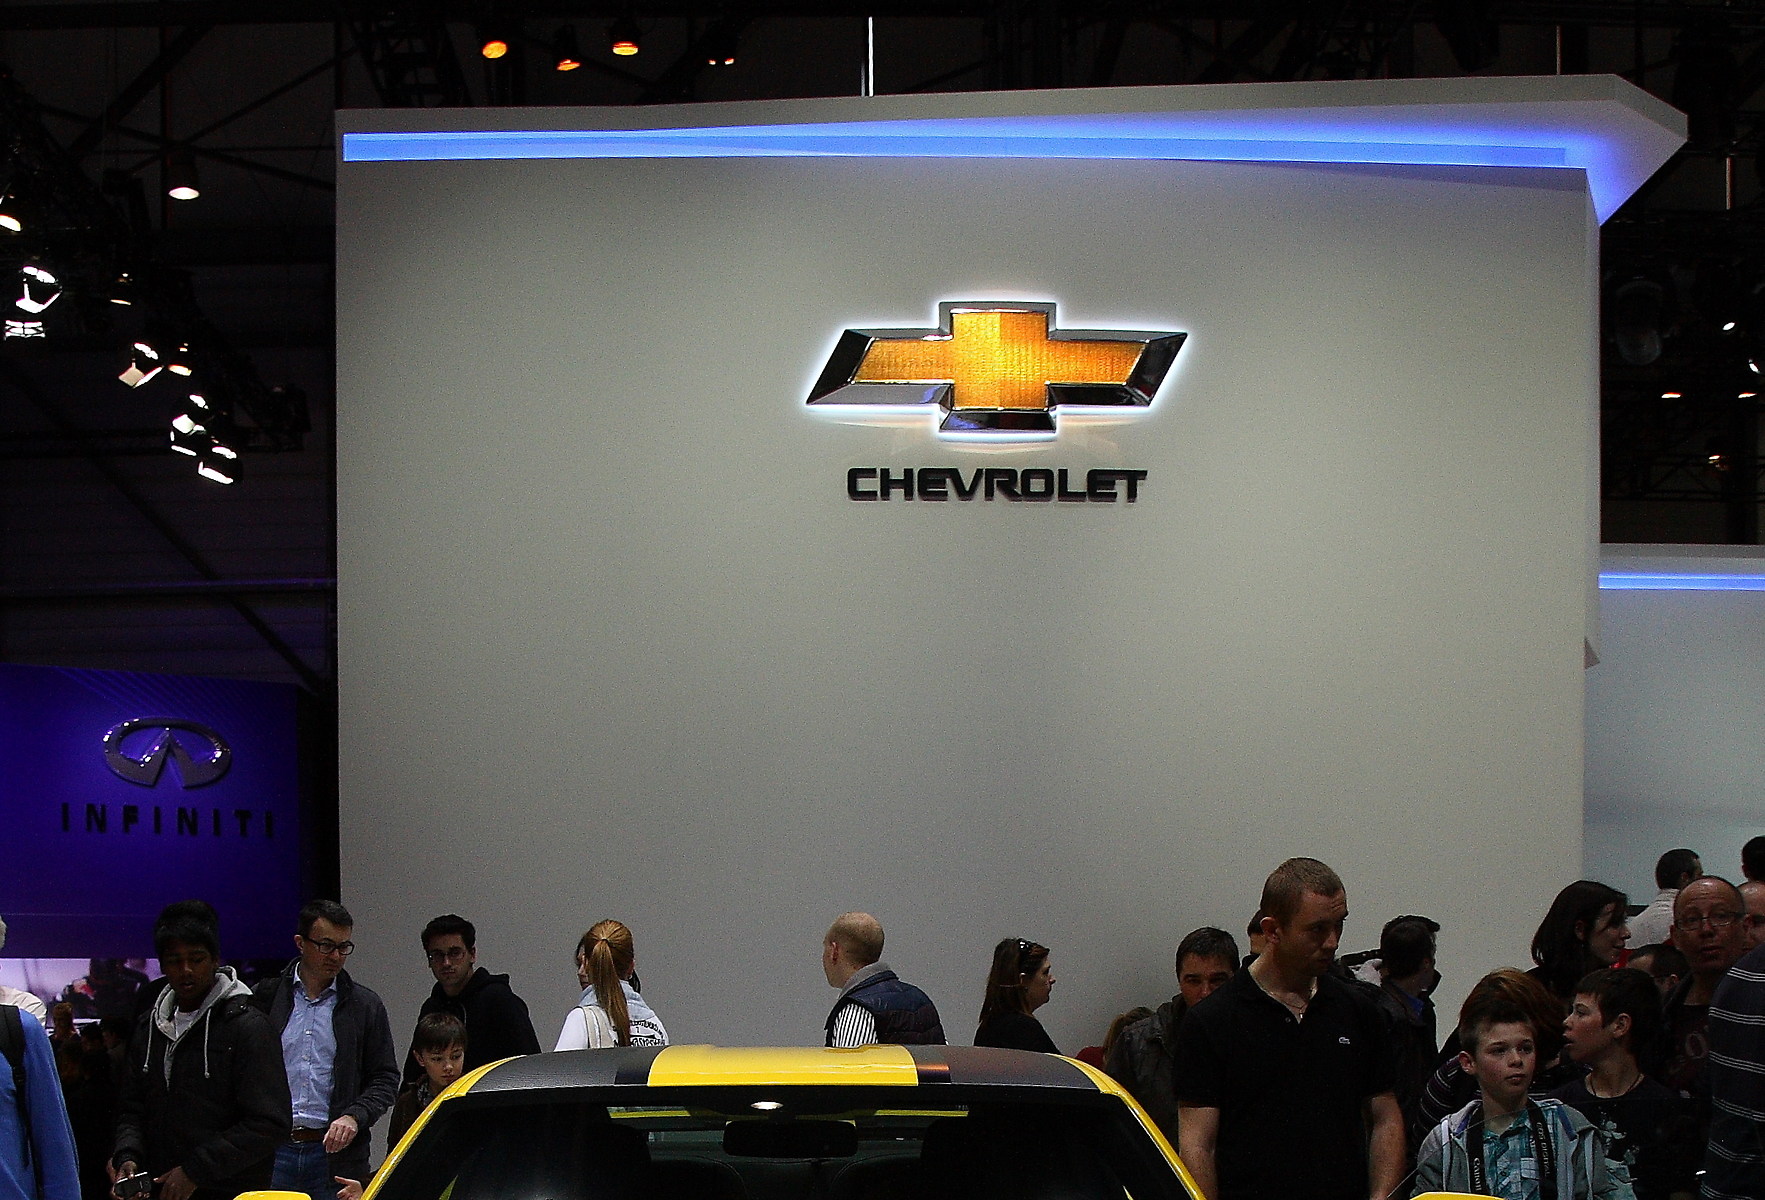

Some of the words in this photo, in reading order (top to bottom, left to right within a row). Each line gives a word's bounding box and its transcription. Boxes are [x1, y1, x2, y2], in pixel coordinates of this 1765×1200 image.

[847, 467, 1148, 503] CHEVROLET
[61, 803, 275, 838] INFINITI
[1473, 1157, 1483, 1191] Canon
[1541, 1142, 1551, 1177] DIGITAL
